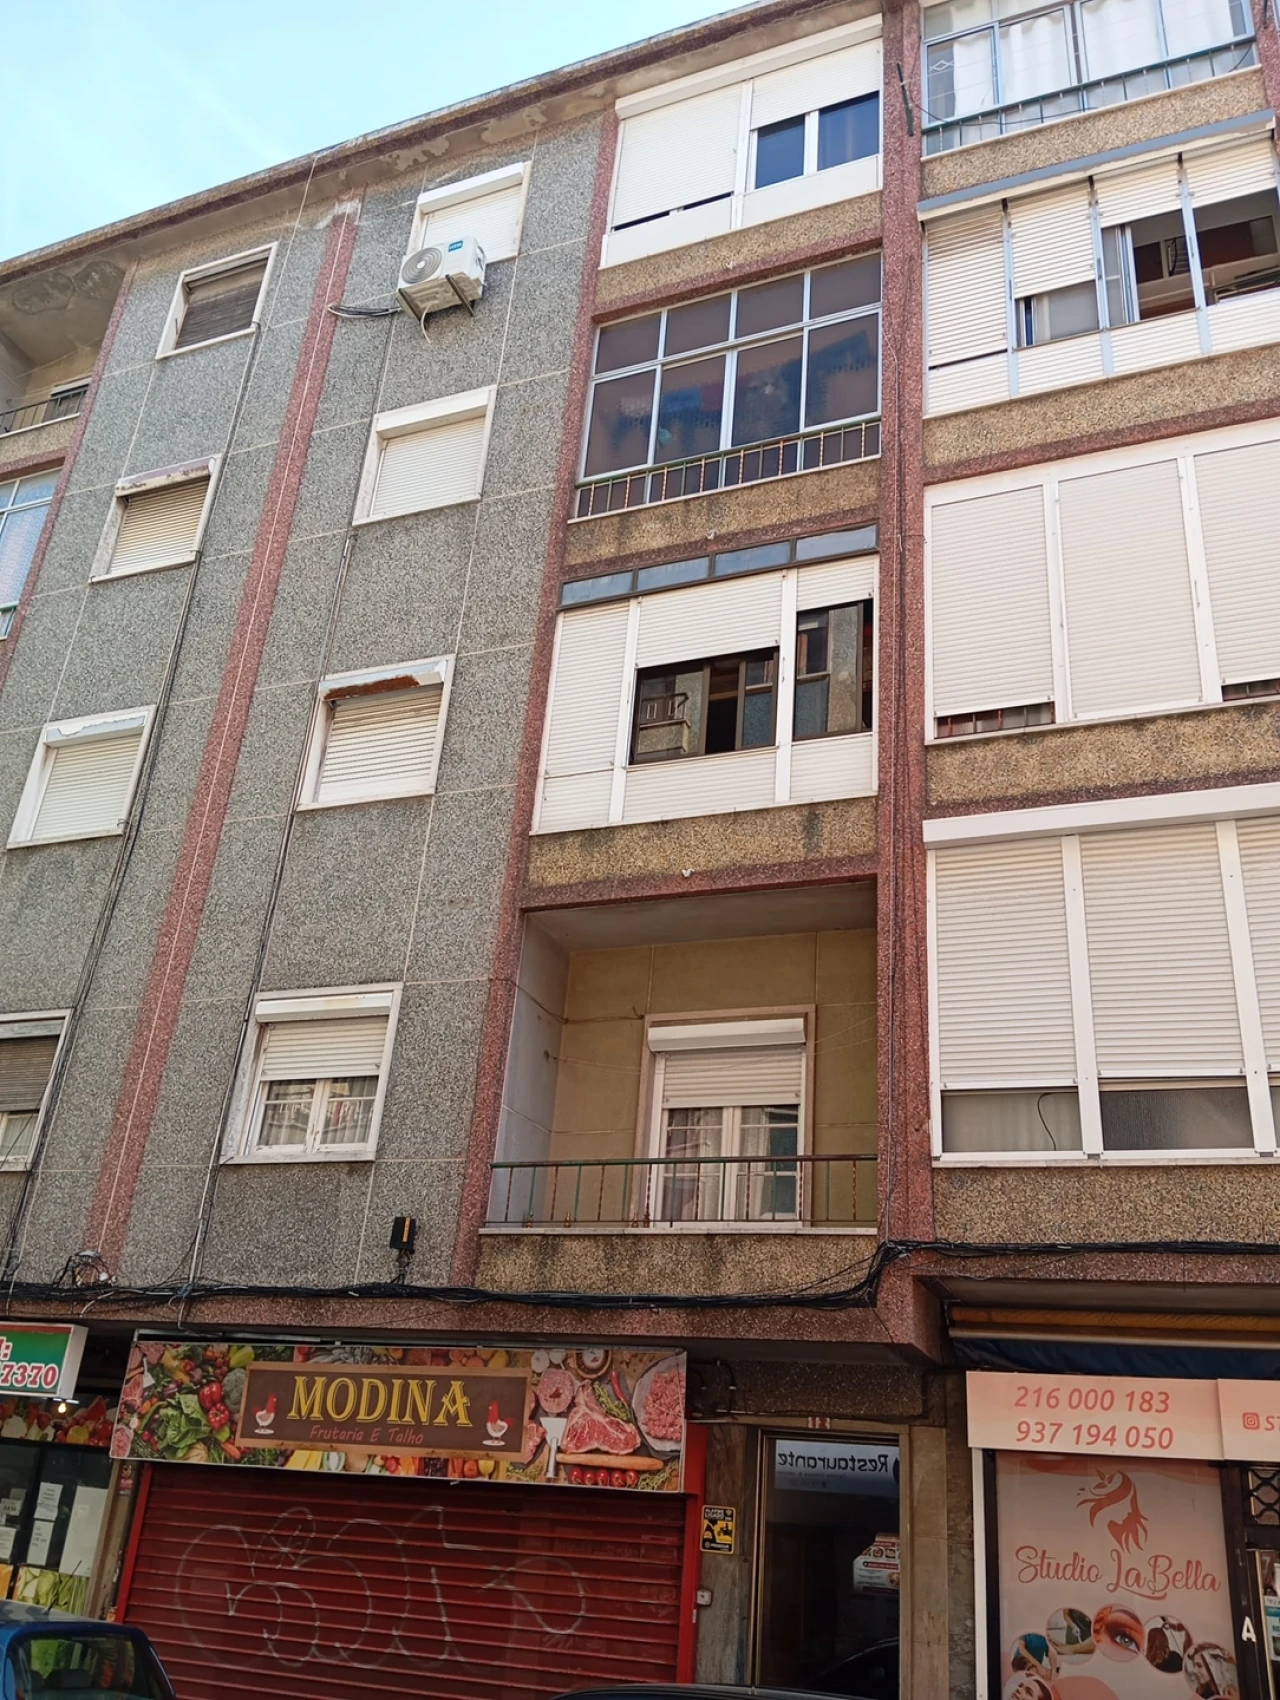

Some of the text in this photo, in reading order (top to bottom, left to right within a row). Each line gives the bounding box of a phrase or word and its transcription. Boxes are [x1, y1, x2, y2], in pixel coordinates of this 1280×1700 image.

[286, 1375, 473, 1427] MODINA
[1014, 1386, 1170, 1413] 216 000 183
[309, 1424, 424, 1445] Frutaria E Talho
[1016, 1420, 1174, 1450] 937 194 050
[1015, 1545, 1103, 1584] Studio
[1241, 1615, 1256, 1643] A
